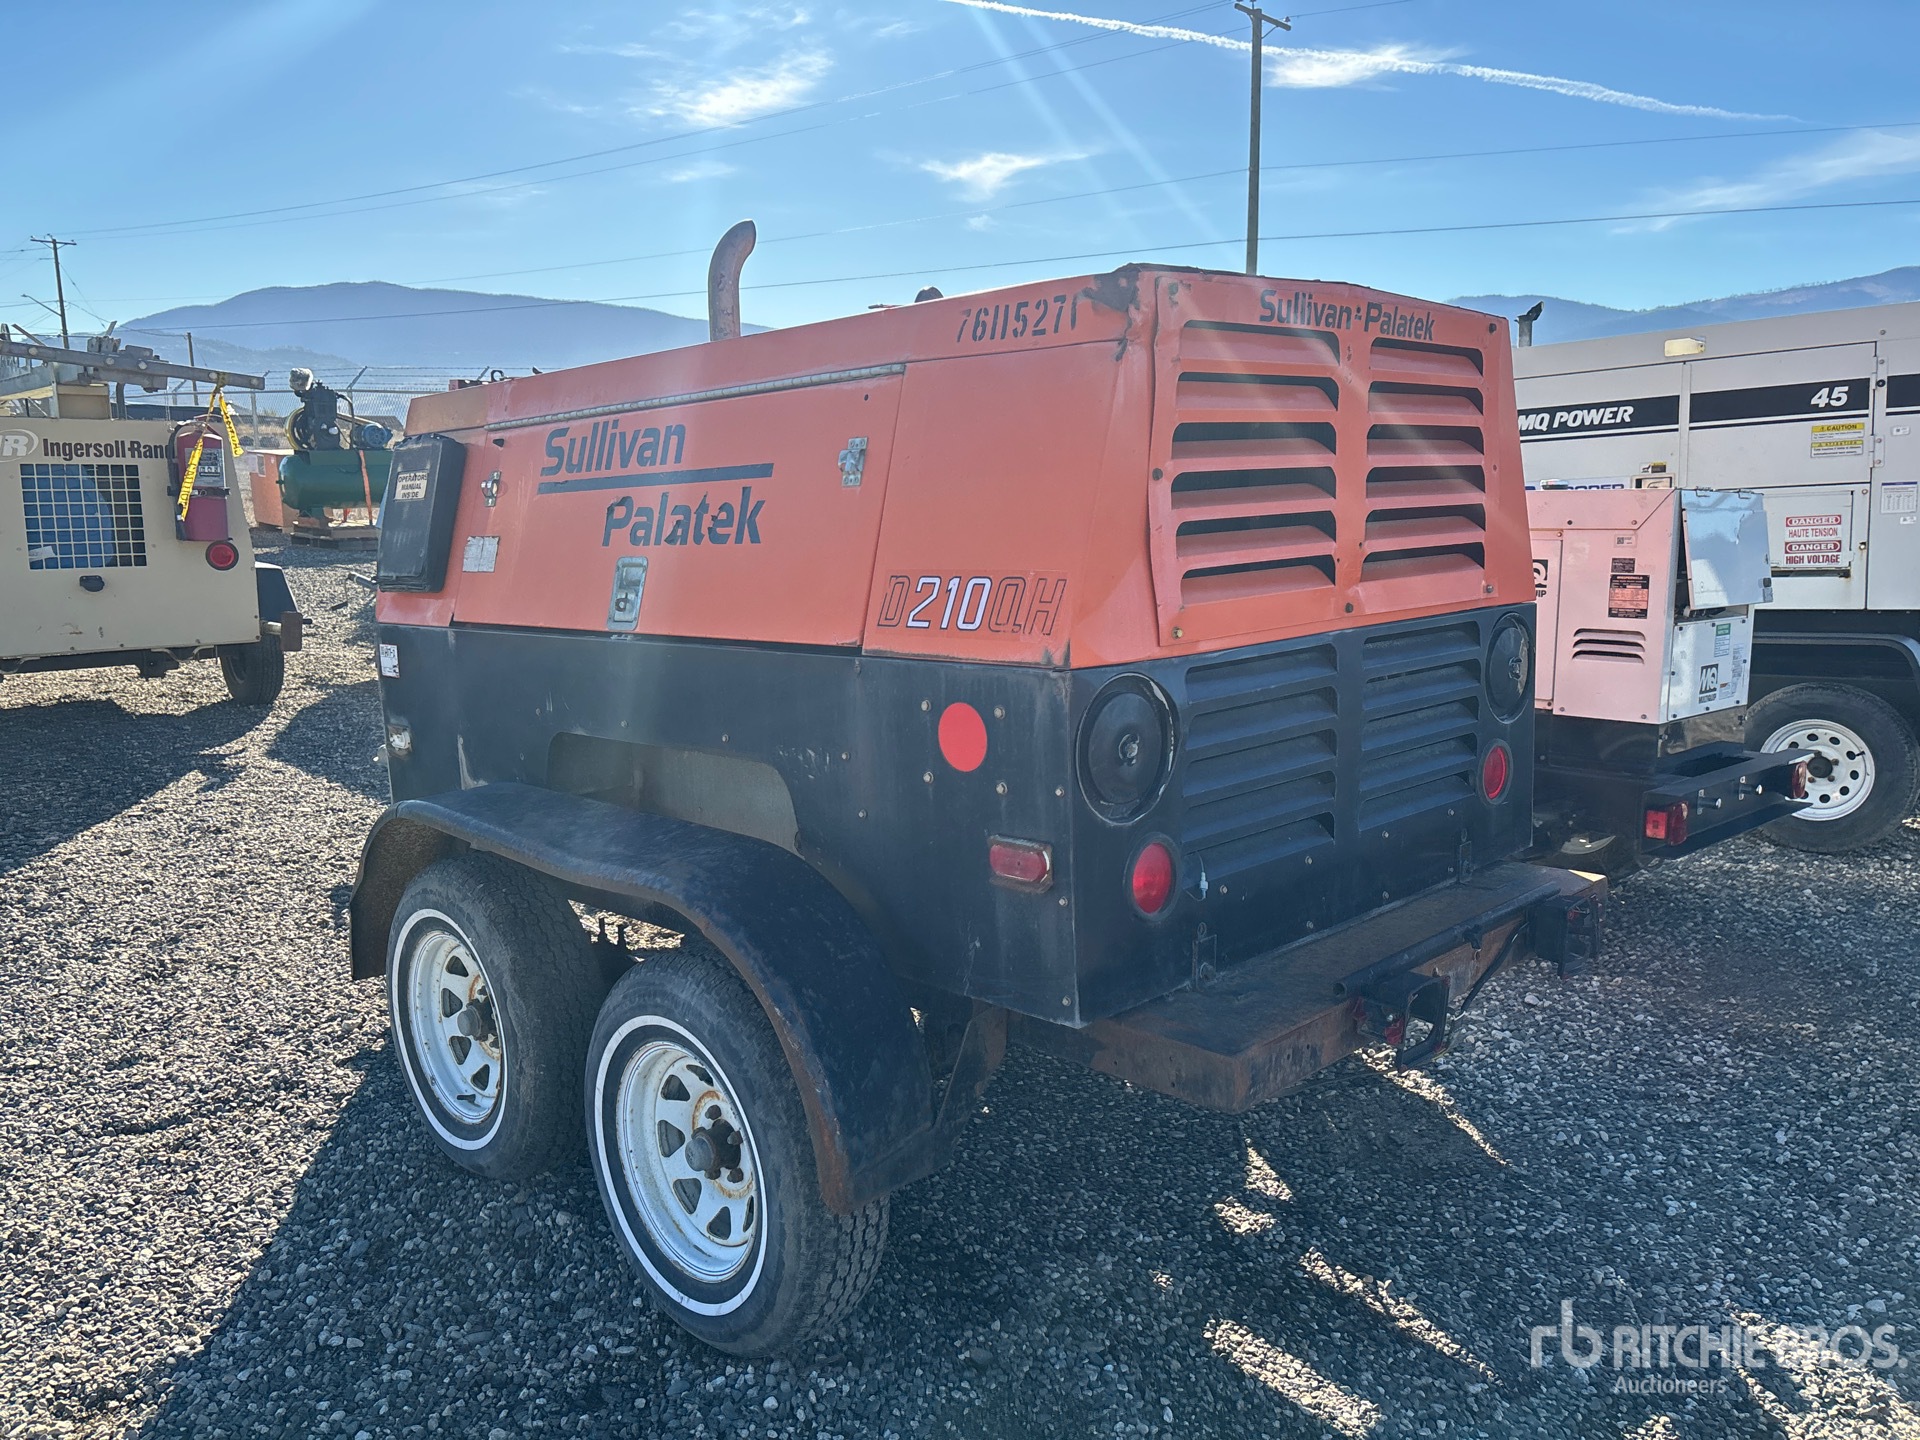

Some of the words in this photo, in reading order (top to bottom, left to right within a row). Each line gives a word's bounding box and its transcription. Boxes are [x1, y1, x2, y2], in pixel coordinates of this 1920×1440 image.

[1259, 289, 1352, 330] Sullivan
[1363, 301, 1436, 341] Palatek
[1810, 386, 1849, 408] 45
[1518, 412, 1551, 431] MQ
[1552, 405, 1634, 429] POWER
[1827, 424, 1857, 432] CAUTION
[0, 435, 29, 457] R
[540, 419, 687, 477] Sullivan
[602, 486, 766, 547] Palatek
[1791, 516, 1836, 525] DANGER
[1788, 528, 1810, 538] HAUTE
[1811, 527, 1838, 537] TENSION
[1791, 543, 1835, 551] DANGER
[1785, 555, 1805, 565] HIGH
[1806, 553, 1841, 564] VOLTAGE
[877, 575, 1067, 636] D210QH
[1700, 667, 1718, 692] MQ
